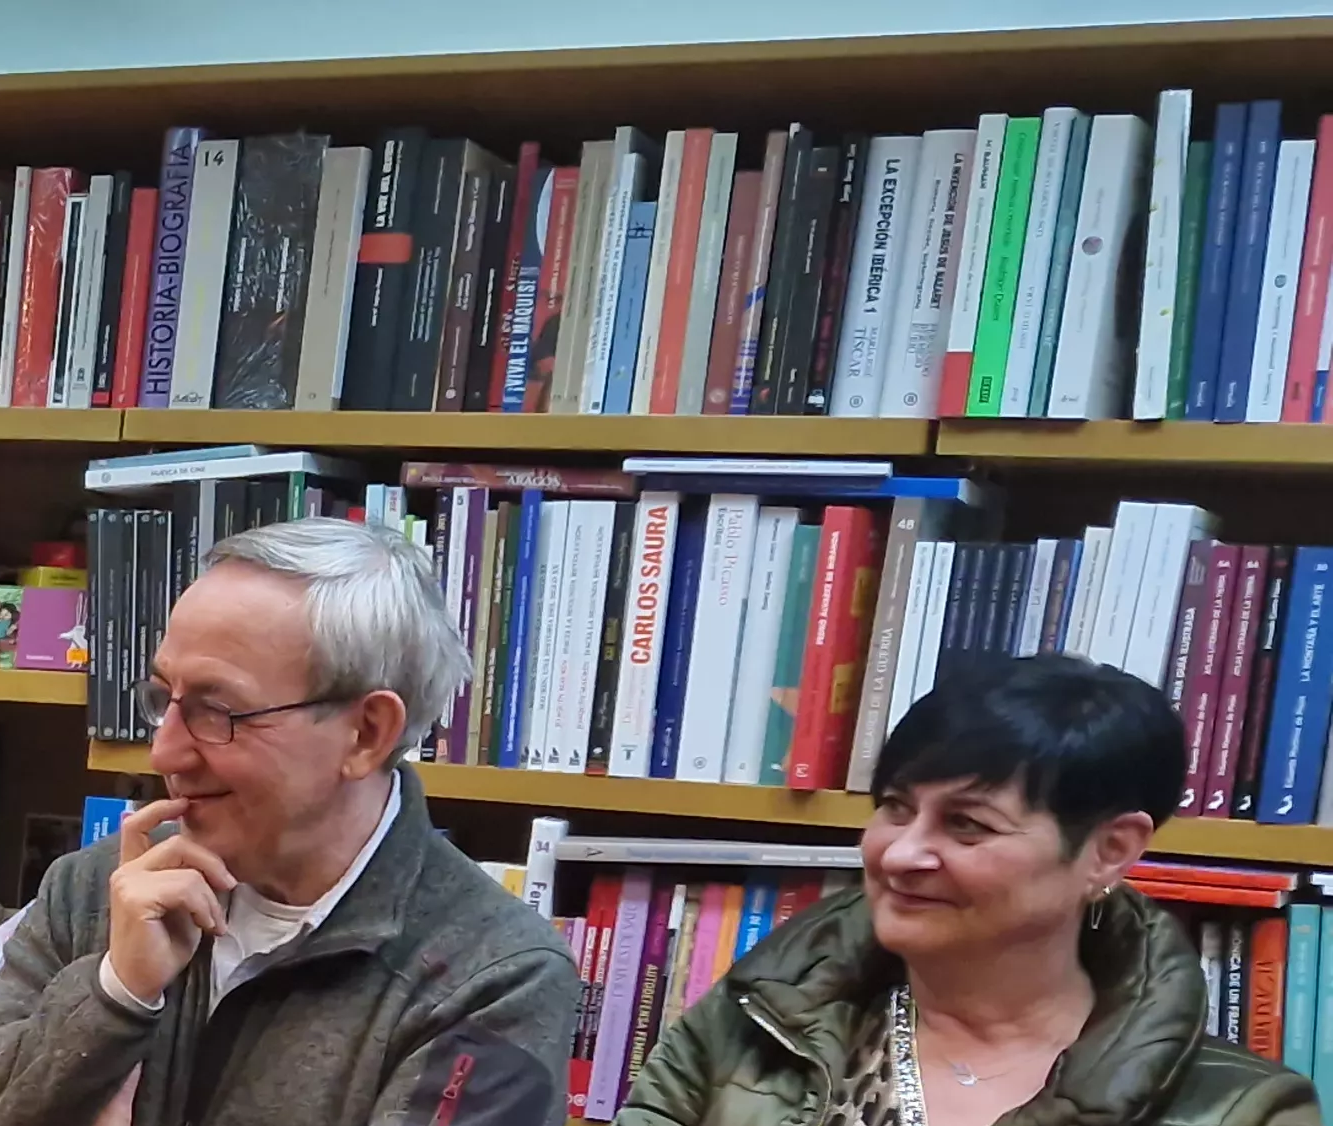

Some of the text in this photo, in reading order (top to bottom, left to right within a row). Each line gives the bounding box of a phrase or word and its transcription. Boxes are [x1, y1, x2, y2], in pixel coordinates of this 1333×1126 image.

[201, 148, 225, 169] 14
[885, 158, 901, 175] LA
[375, 214, 386, 227] LA
[873, 178, 898, 250] EXCEPCIÓN
[929, 152, 965, 310] LA INVENCIÓN DE JESÚS DE NAZARET
[145, 143, 191, 395] HISTORIA-BIOGRAFÍA
[865, 254, 887, 305] IBÉRICA
[507, 280, 536, 392] ¡VIVA EL MAQUIS!
[847, 327, 869, 378] TÍSCAR
[897, 516, 915, 531] 48
[718, 508, 744, 607] Pablo Picasso
[630, 506, 668, 665] CARLOS SAURA
[815, 619, 828, 646] PEDRO
[826, 530, 841, 569] MIRANDA
[1312, 583, 1325, 606] ARTE
[1211, 609, 1221, 618] DE
[1213, 598, 1223, 608] LA
[1240, 611, 1250, 620] DE
[1242, 599, 1252, 609] LA
[1301, 628, 1318, 669] MONTAÑA
[1233, 655, 1244, 676] ATLAS
[1299, 670, 1311, 682] LA
[861, 627, 894, 759] LUGARES DE LA GUERRA
[536, 841, 550, 853] 34
[1228, 973, 1242, 1003] DE UN
[627, 963, 658, 1082] AUTODEFENSA FEMINISTA
